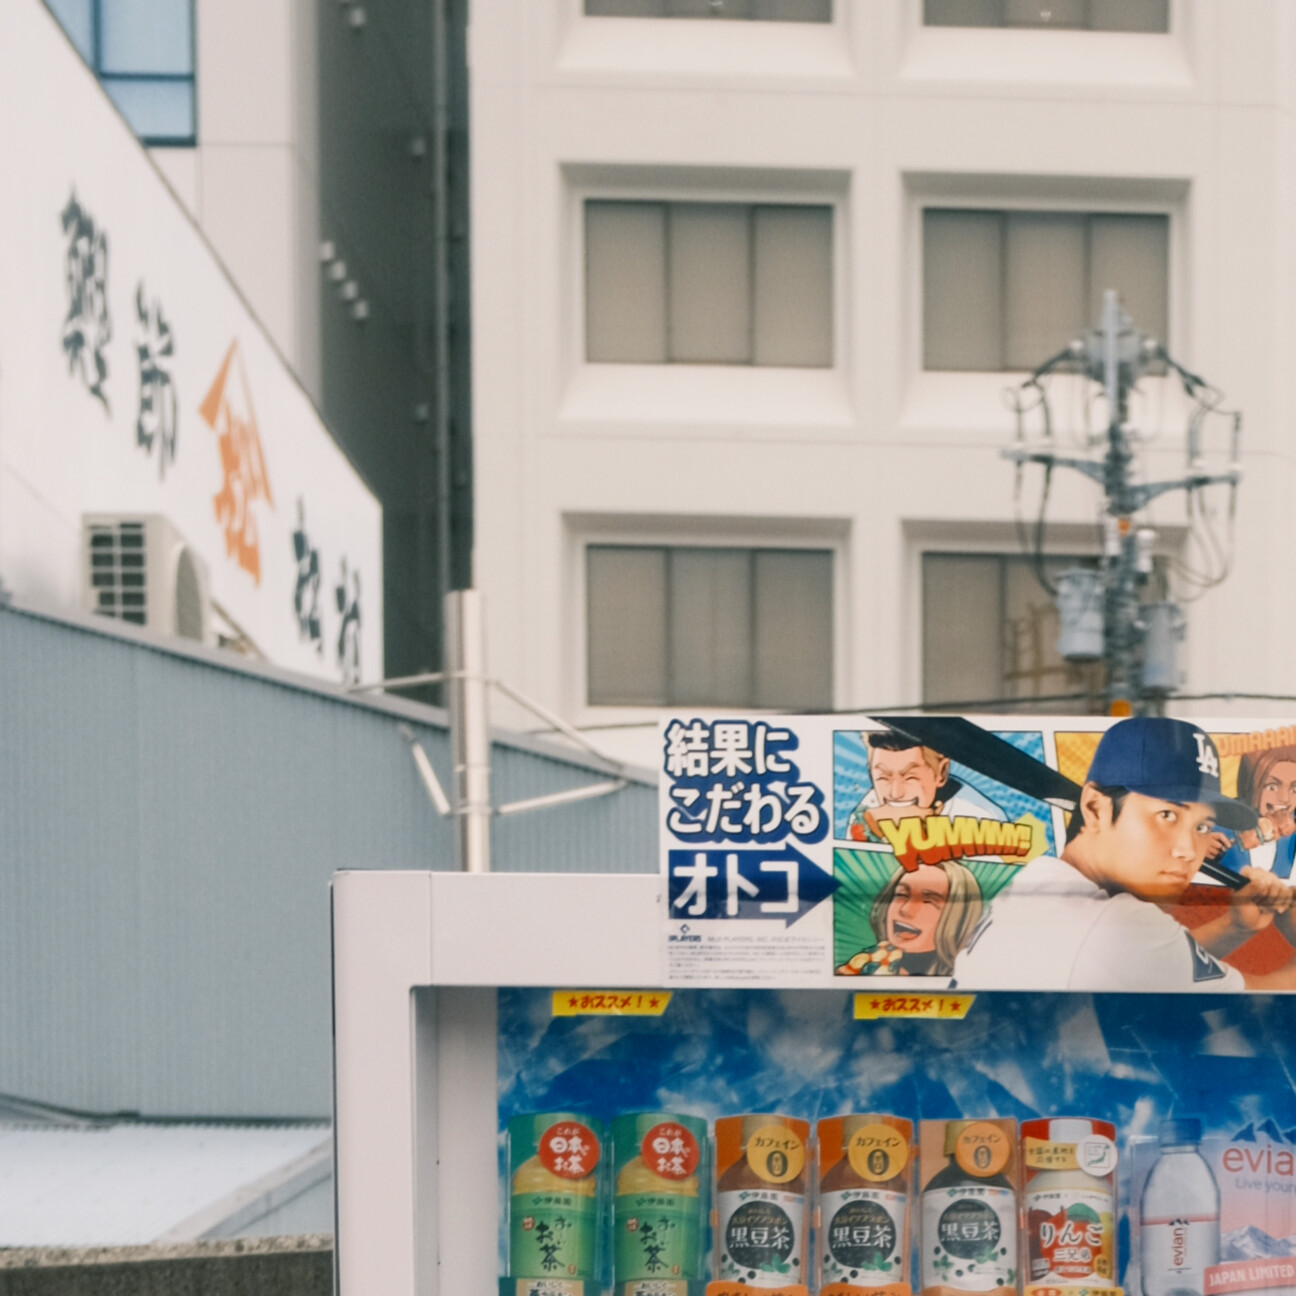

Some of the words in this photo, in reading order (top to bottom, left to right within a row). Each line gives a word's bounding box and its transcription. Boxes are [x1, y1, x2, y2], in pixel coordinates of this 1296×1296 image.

[669, 721, 791, 779] 結果に
[1193, 733, 1219, 778] LA
[668, 782, 821, 834] こだわる
[673, 853, 799, 916] オトコ
[554, 1156, 585, 1174] お茶
[656, 1156, 686, 1175] お茶
[729, 1227, 790, 1250] 黒豆茶
[831, 1225, 892, 1249] 黒豆茶
[942, 1221, 1000, 1243] 黒豆茶
[1040, 1222, 1104, 1247] りんご
[1173, 1227, 1185, 1267] evian
[1209, 1270, 1246, 1287] JAPAN
[1249, 1266, 1294, 1281] LIMITED
